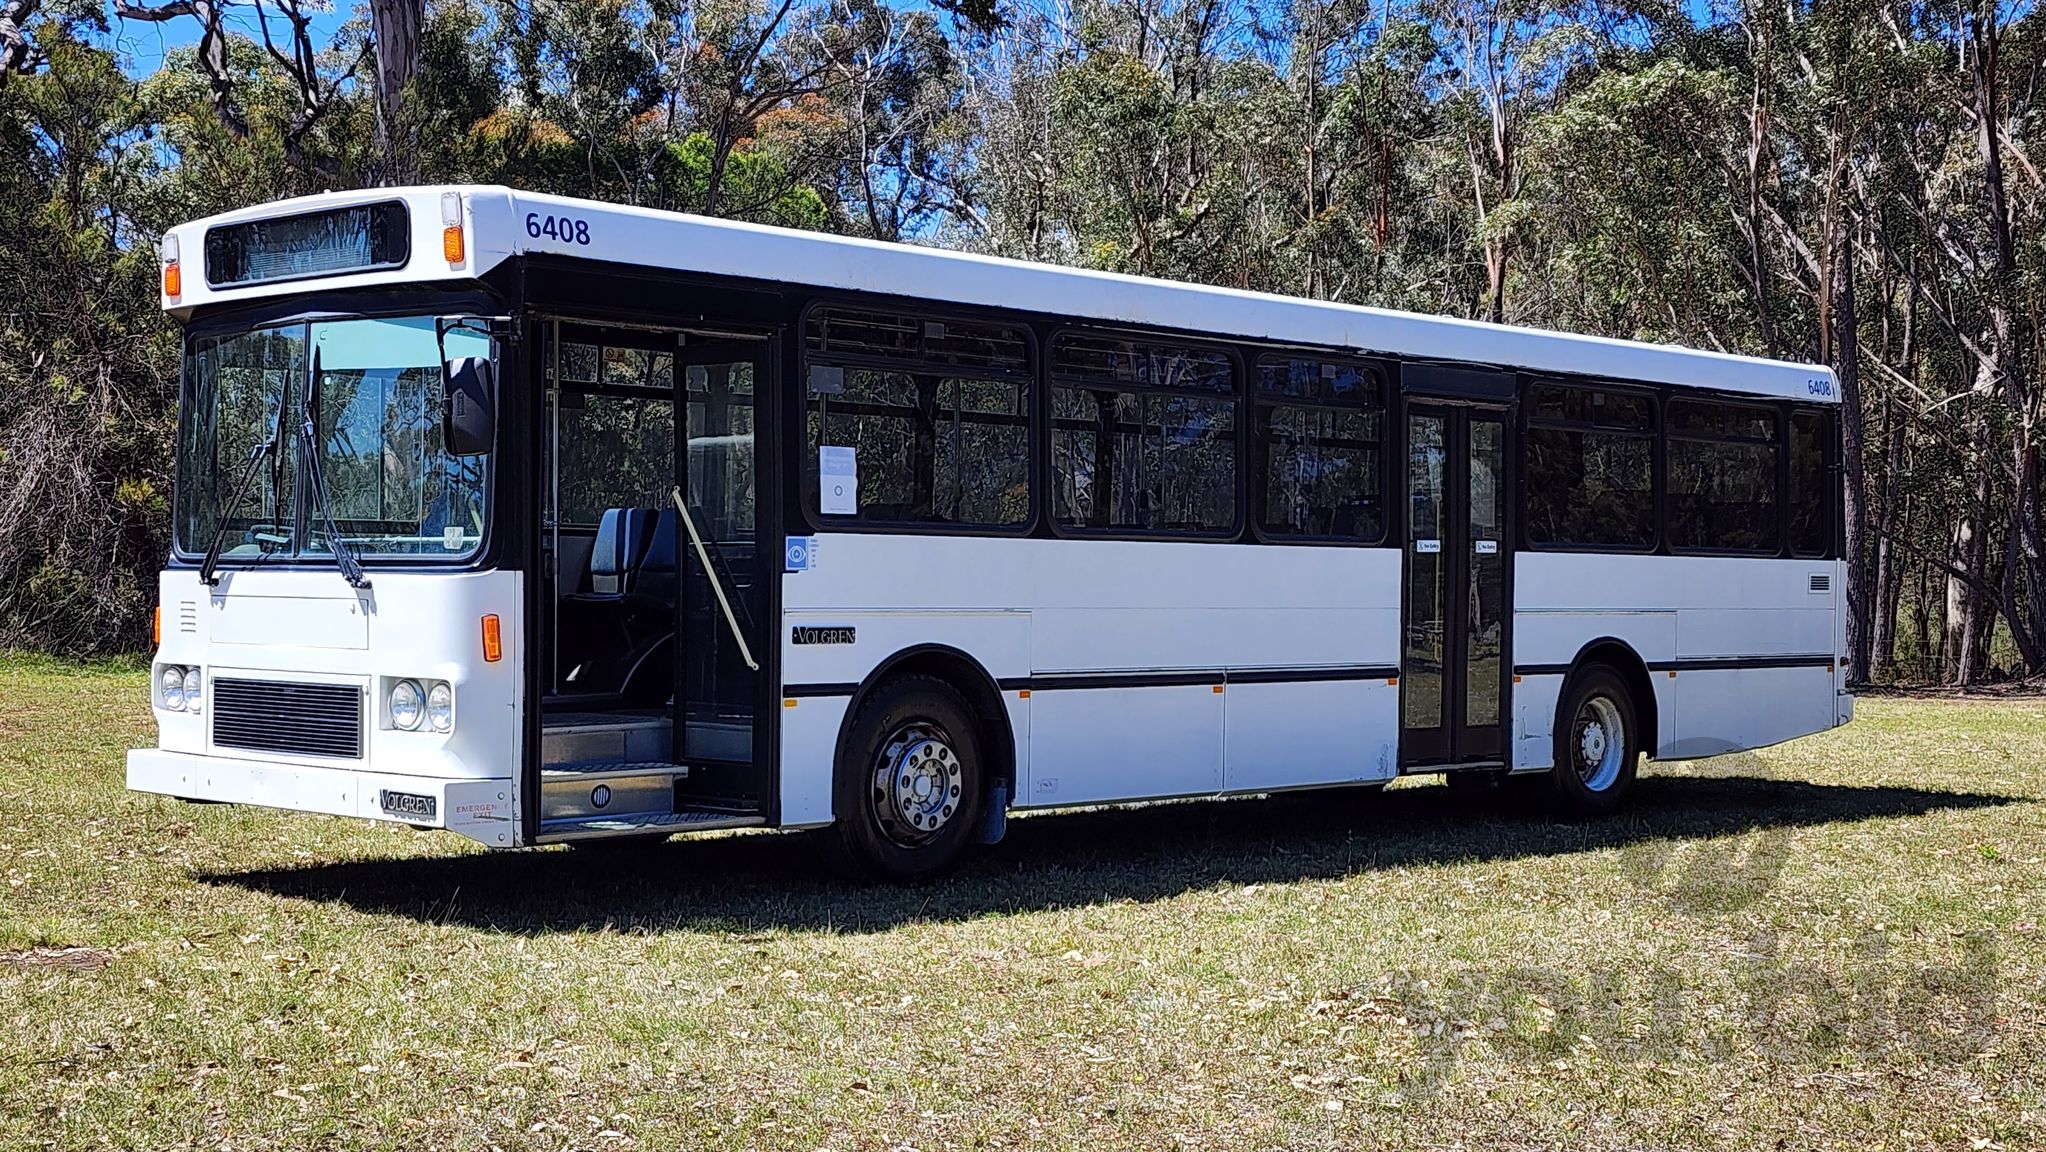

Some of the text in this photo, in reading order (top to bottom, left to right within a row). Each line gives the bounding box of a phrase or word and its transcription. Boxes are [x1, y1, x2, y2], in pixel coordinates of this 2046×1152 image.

[526, 212, 591, 246] 6408
[1808, 379, 1832, 397] 6408
[796, 627, 855, 645] VOLGREN
[380, 789, 434, 816] VOLGREN
[473, 811, 492, 819] EXIT
